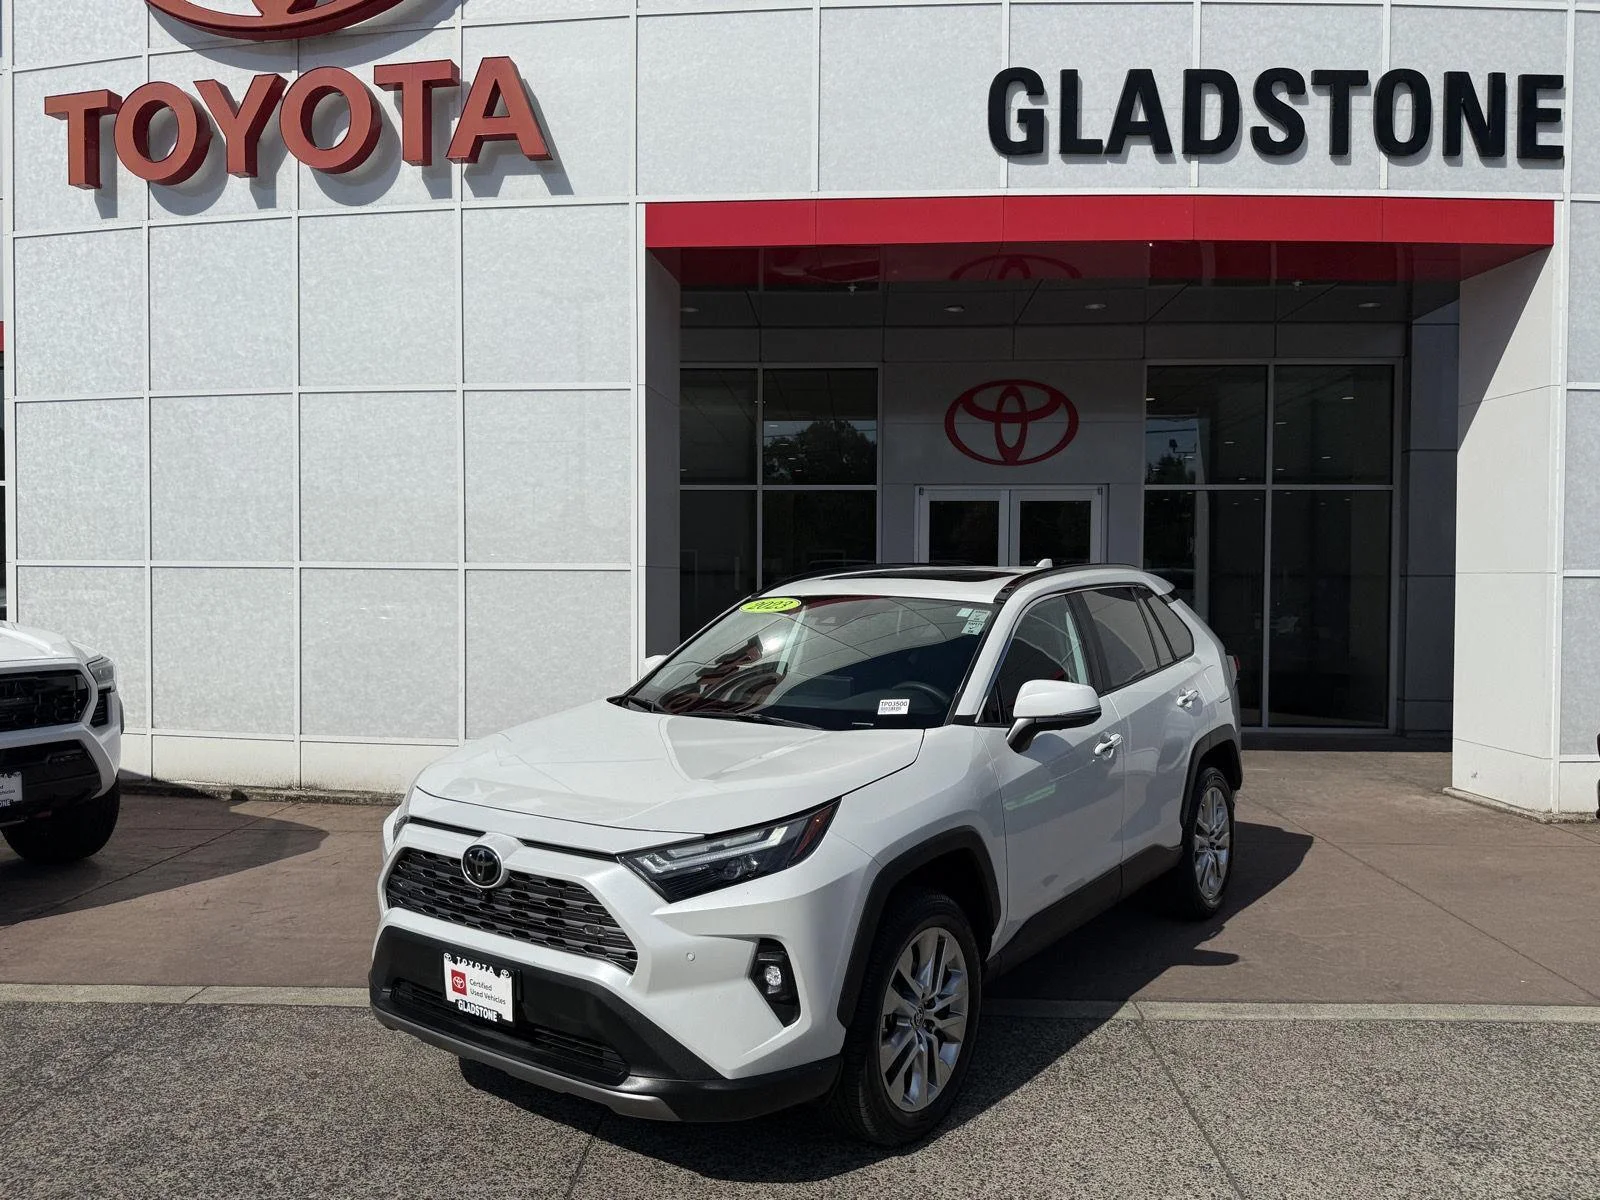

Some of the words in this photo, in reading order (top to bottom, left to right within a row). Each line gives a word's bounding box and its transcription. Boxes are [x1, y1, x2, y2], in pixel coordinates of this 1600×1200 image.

[987, 66, 1565, 160] GLADSTONE
[44, 56, 553, 190] TOYOTA
[746, 600, 794, 610] 2023
[456, 956, 495, 974] TOYOTA
[469, 978, 493, 992] Certified
[470, 987, 484, 998] Used
[484, 992, 506, 1006] Vehicles
[458, 999, 498, 1022] GLADSTONE
